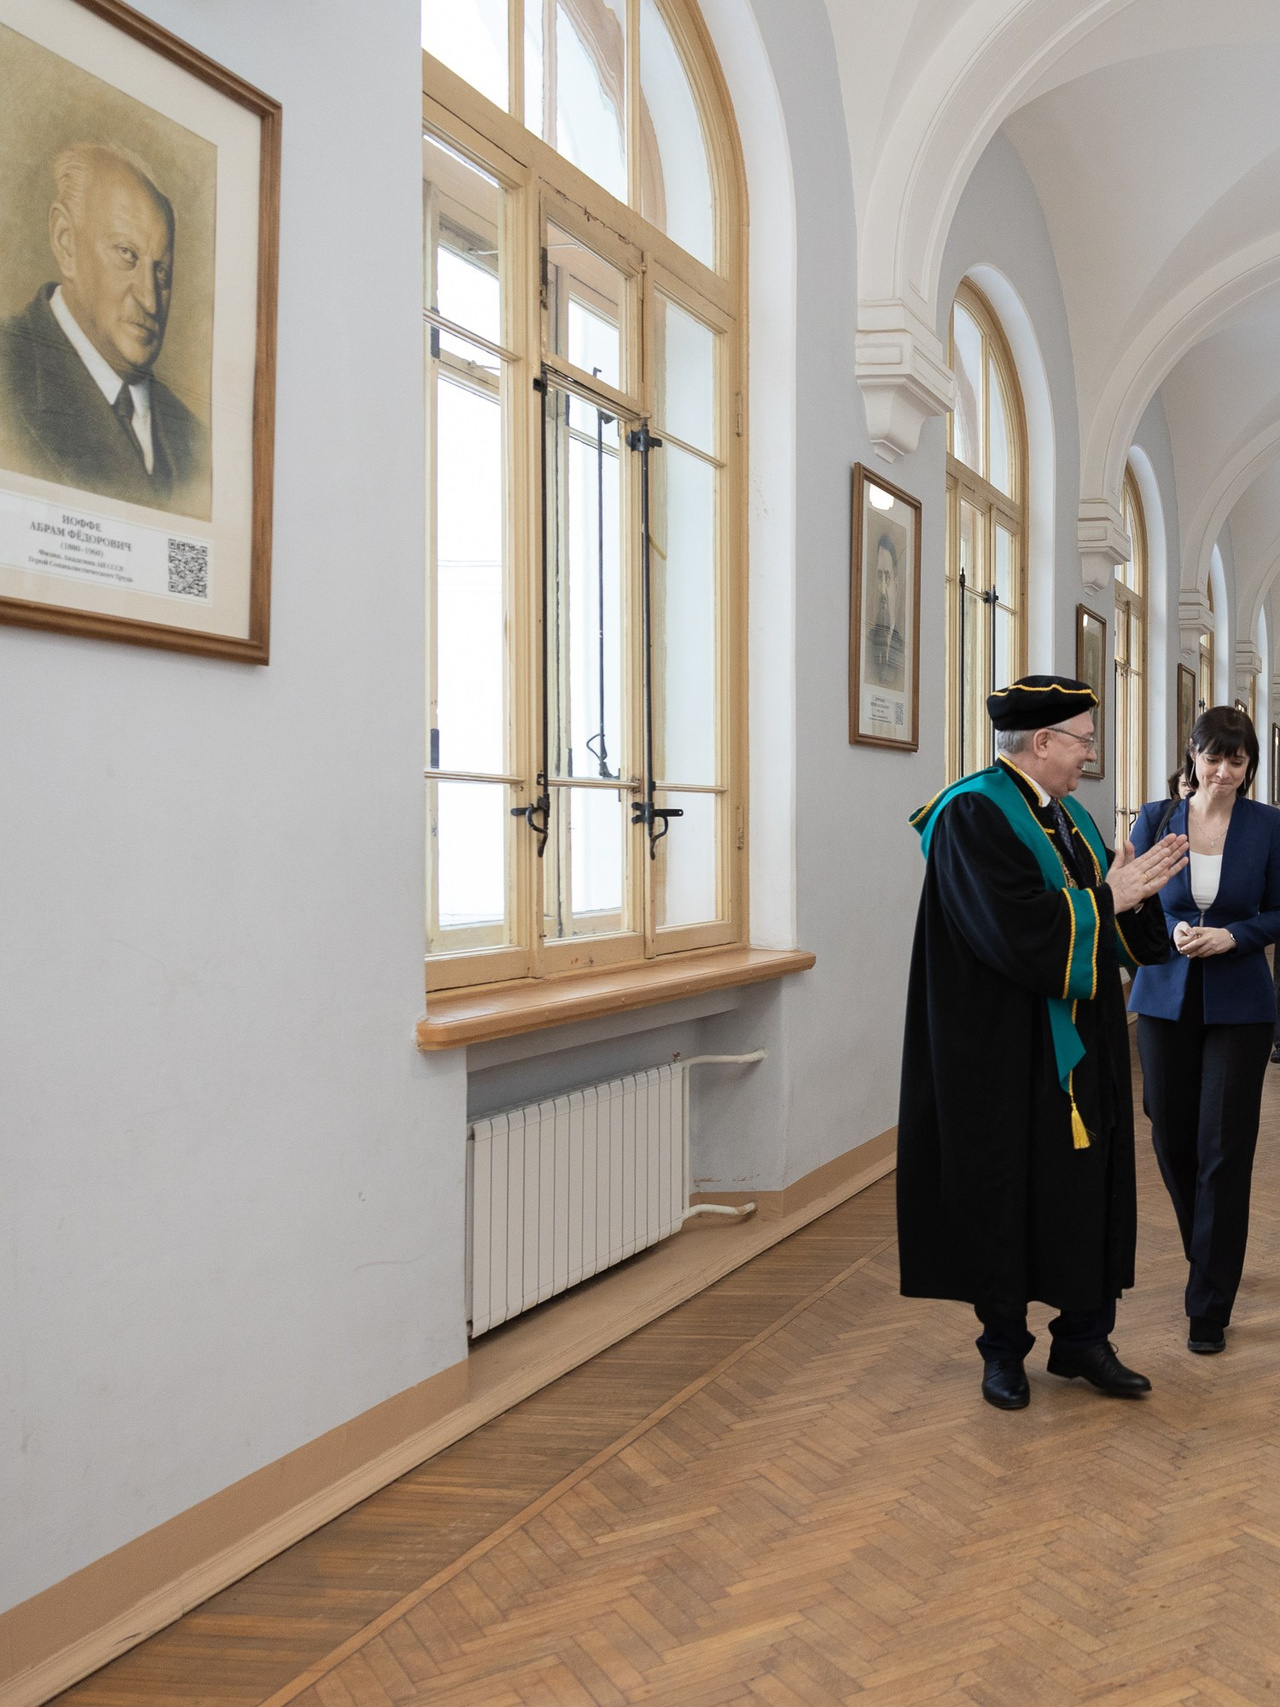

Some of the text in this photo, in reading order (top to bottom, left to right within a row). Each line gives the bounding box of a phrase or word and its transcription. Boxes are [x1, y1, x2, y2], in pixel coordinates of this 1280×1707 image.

[62, 514, 102, 532] ИОФФЕ
[29, 521, 132, 552] АБРАМ ФЁДОРОВИЧ
